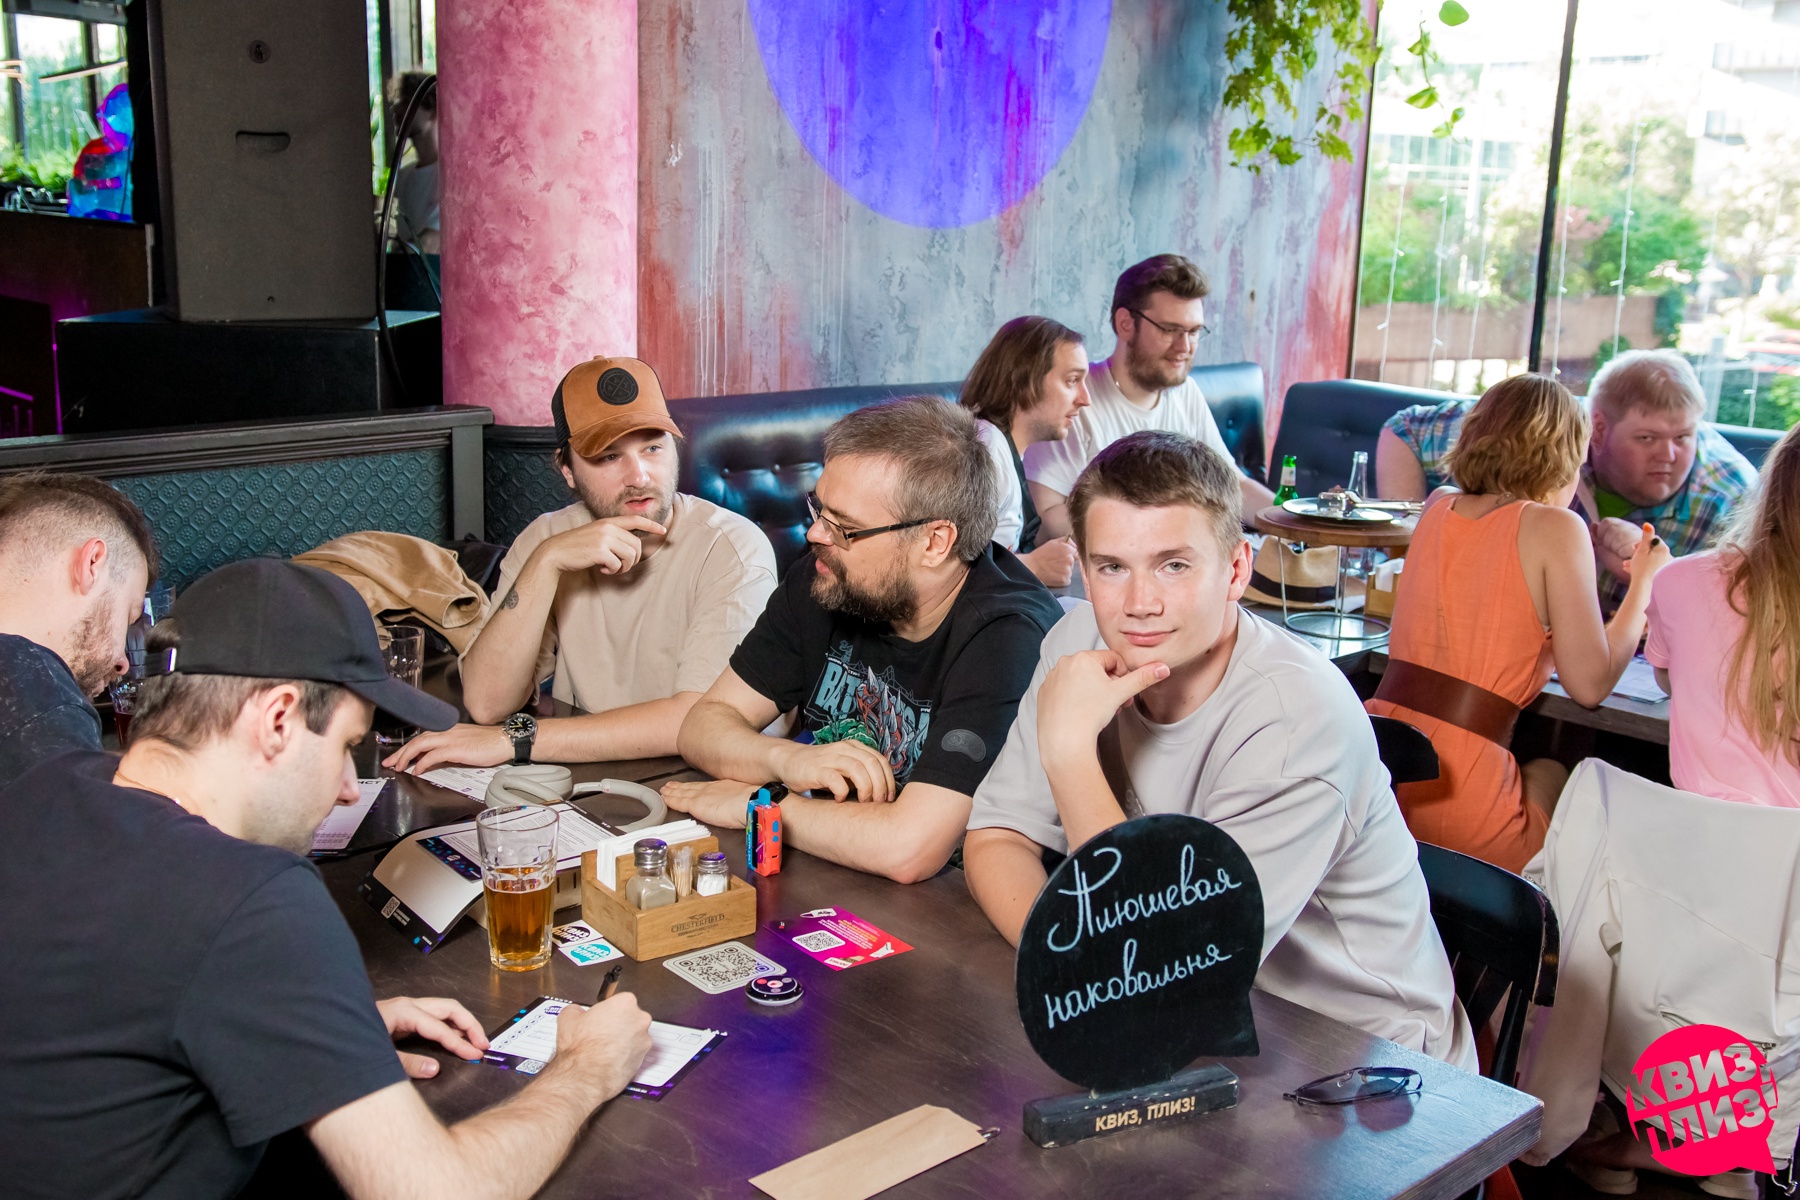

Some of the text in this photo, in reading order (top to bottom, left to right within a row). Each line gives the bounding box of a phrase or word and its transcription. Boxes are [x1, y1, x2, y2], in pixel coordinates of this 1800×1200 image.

[671, 912, 725, 933] CHESTERFIELD
[1047, 844, 1241, 952] Плюшевая
[1045, 938, 1232, 1029] наковальня
[1095, 1096, 1196, 1132] КВИЗ, ПЛИЗ!
